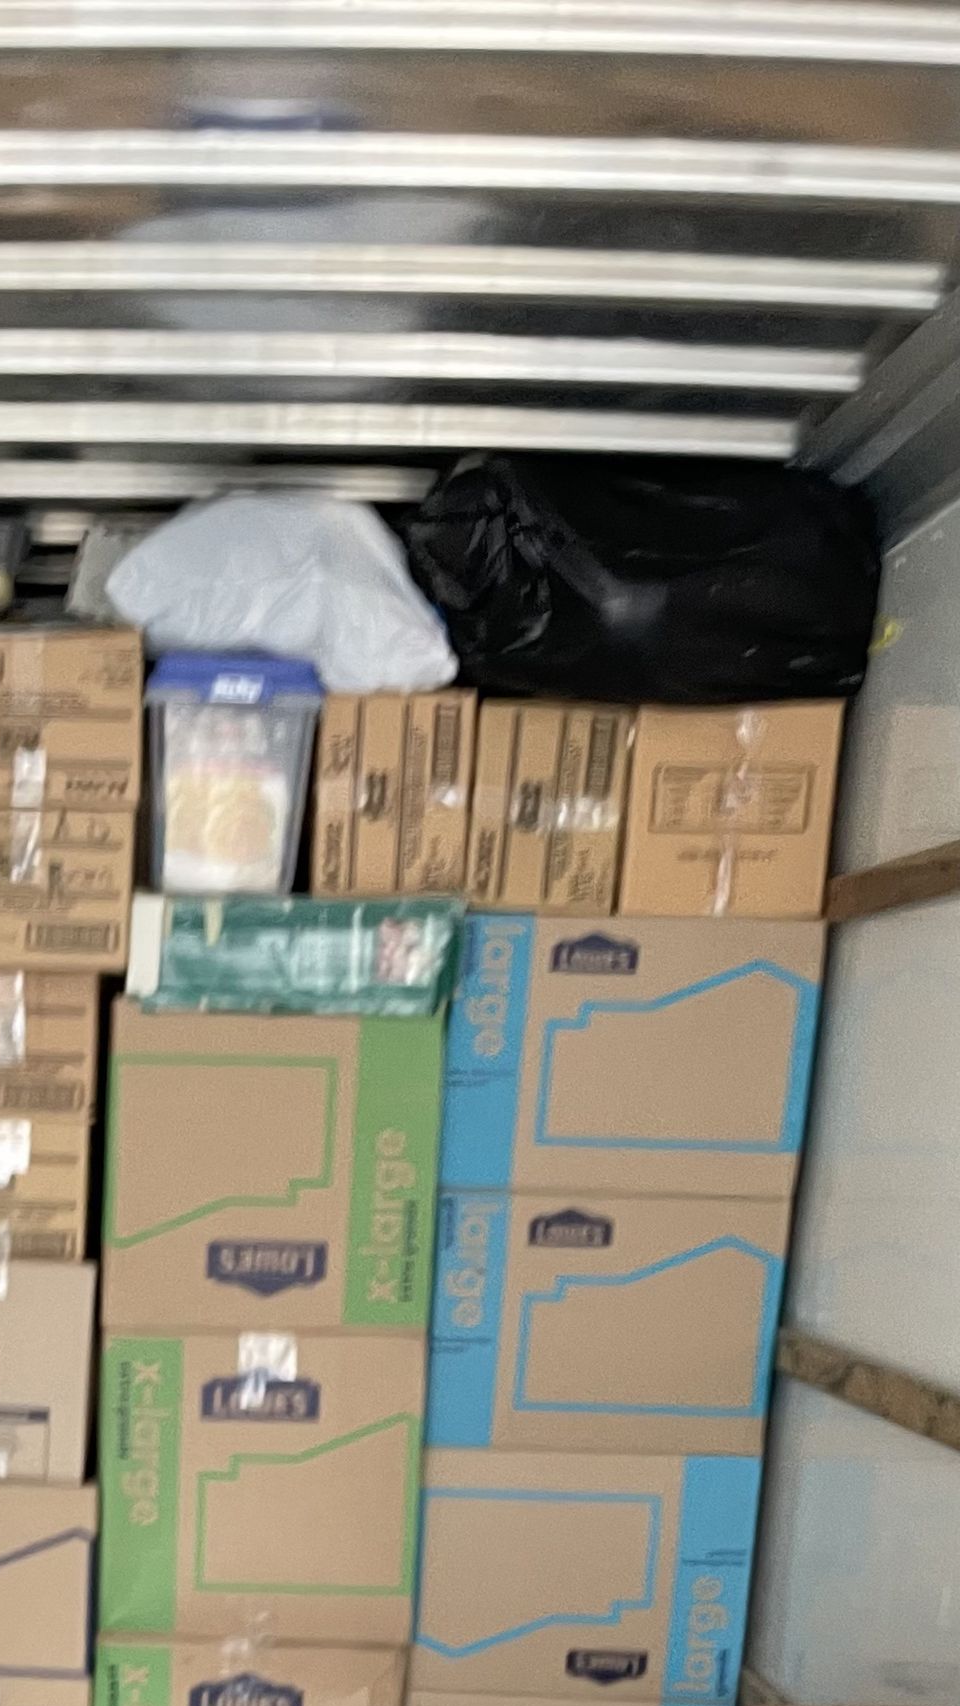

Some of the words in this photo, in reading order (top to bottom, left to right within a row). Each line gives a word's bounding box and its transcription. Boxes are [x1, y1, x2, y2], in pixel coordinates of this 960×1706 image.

[466, 924, 524, 1057] large
[360, 1128, 416, 1305] x-large
[445, 1201, 500, 1329] large
[120, 1359, 170, 1528] x-large
[673, 1574, 730, 1694] large
